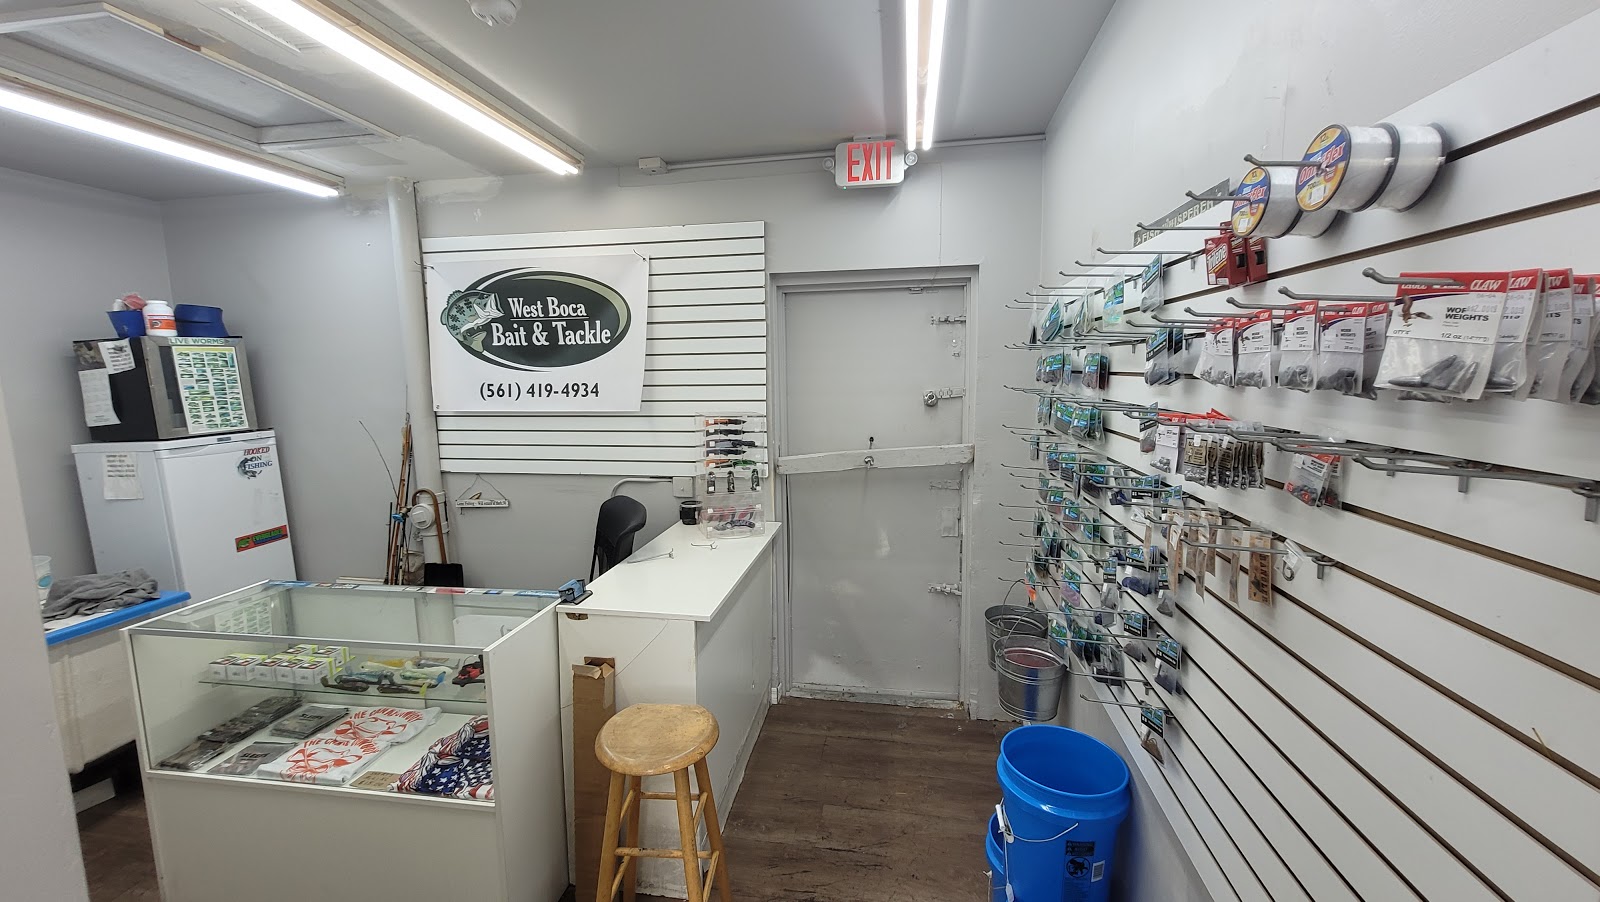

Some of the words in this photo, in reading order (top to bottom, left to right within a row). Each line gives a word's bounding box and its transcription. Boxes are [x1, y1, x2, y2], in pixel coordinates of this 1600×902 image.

[847, 141, 896, 183] EXIT
[1470, 280, 1502, 290] CLAW
[1509, 276, 1534, 289] LAW
[507, 297, 545, 318] West
[546, 296, 587, 317] Boca
[491, 322, 528, 346] Bait
[532, 321, 550, 346] &
[552, 320, 611, 345] Tackle
[480, 382, 521, 401] (561)
[526, 382, 599, 398] 419-4934
[243, 446, 270, 456] HOOKED
[246, 461, 273, 470] FISHING
